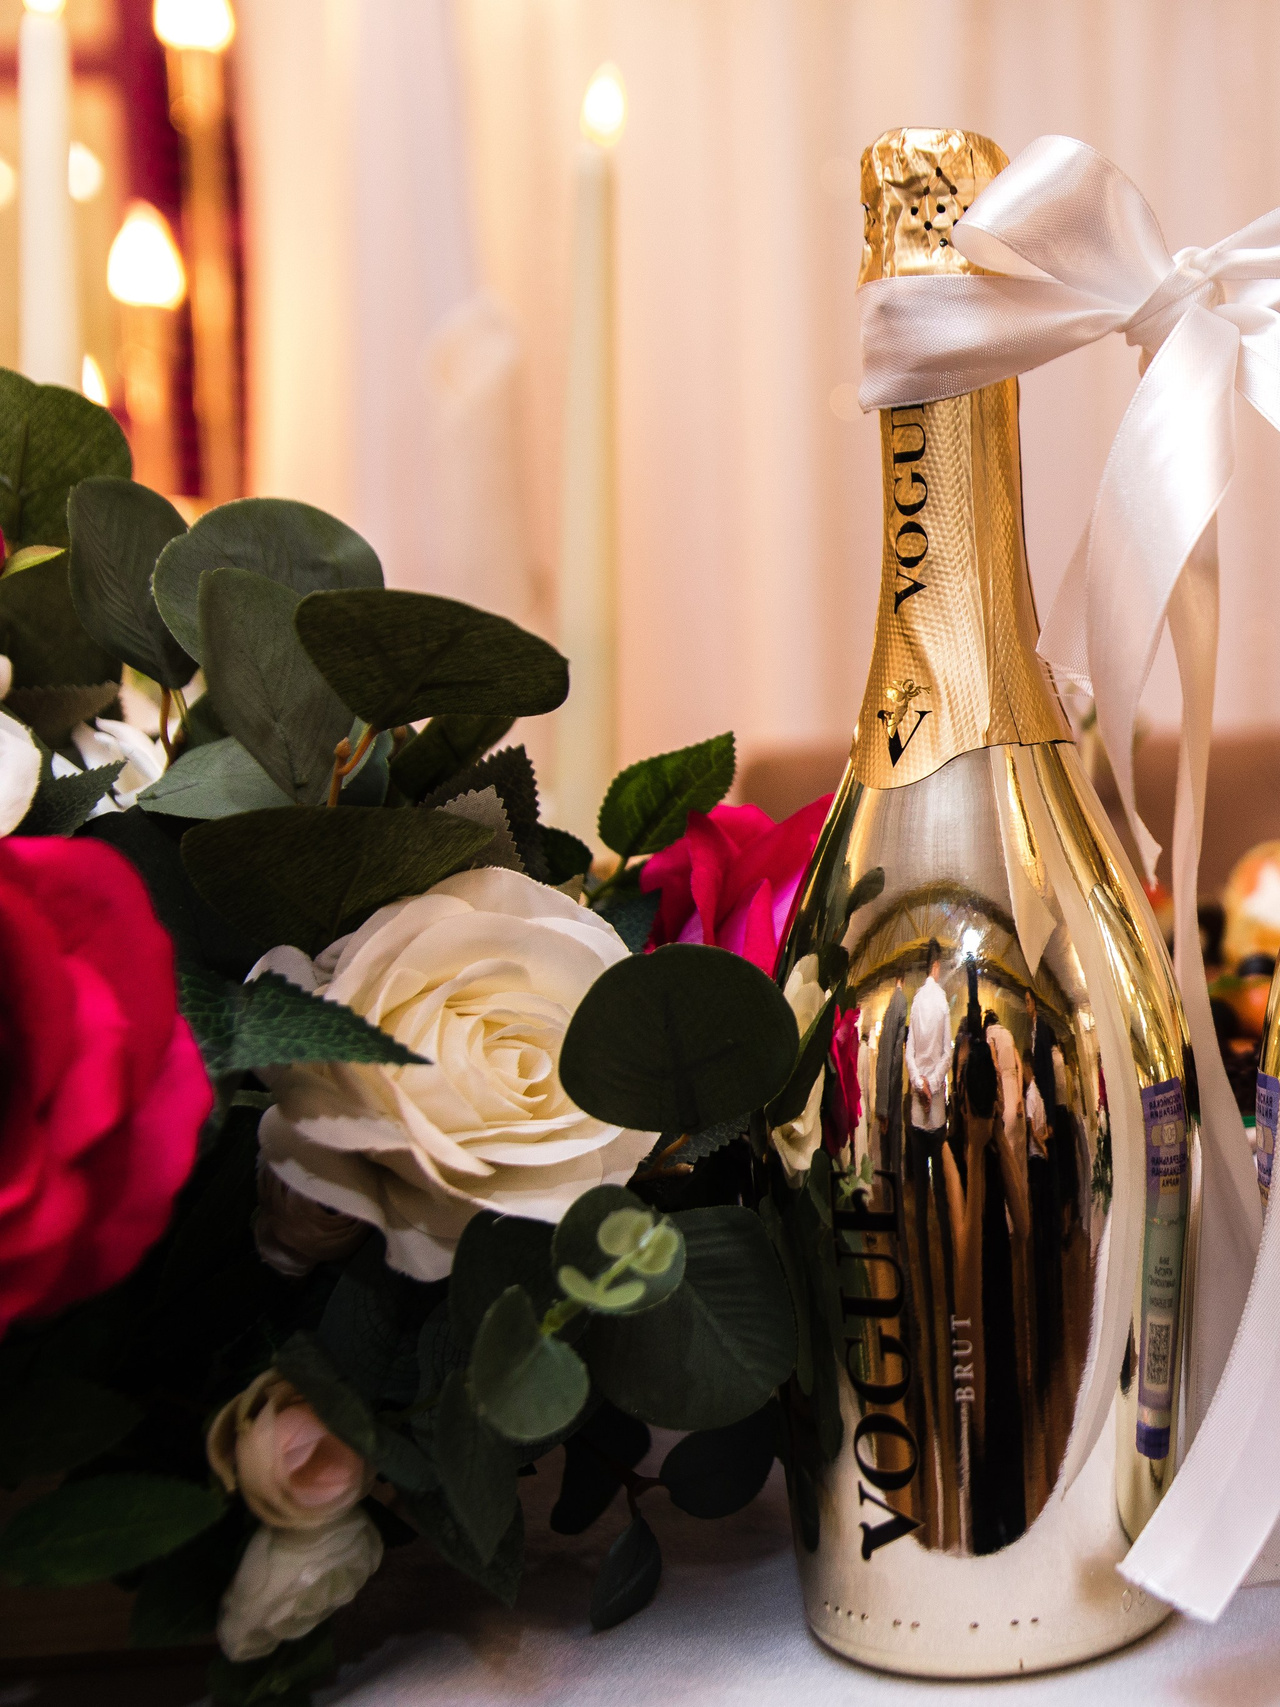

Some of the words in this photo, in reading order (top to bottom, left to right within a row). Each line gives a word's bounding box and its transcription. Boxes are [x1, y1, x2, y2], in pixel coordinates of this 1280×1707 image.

[890, 403, 929, 615] VOGU
[828, 1169, 925, 1561] VOGUE
[950, 1314, 975, 1403] BRUT
